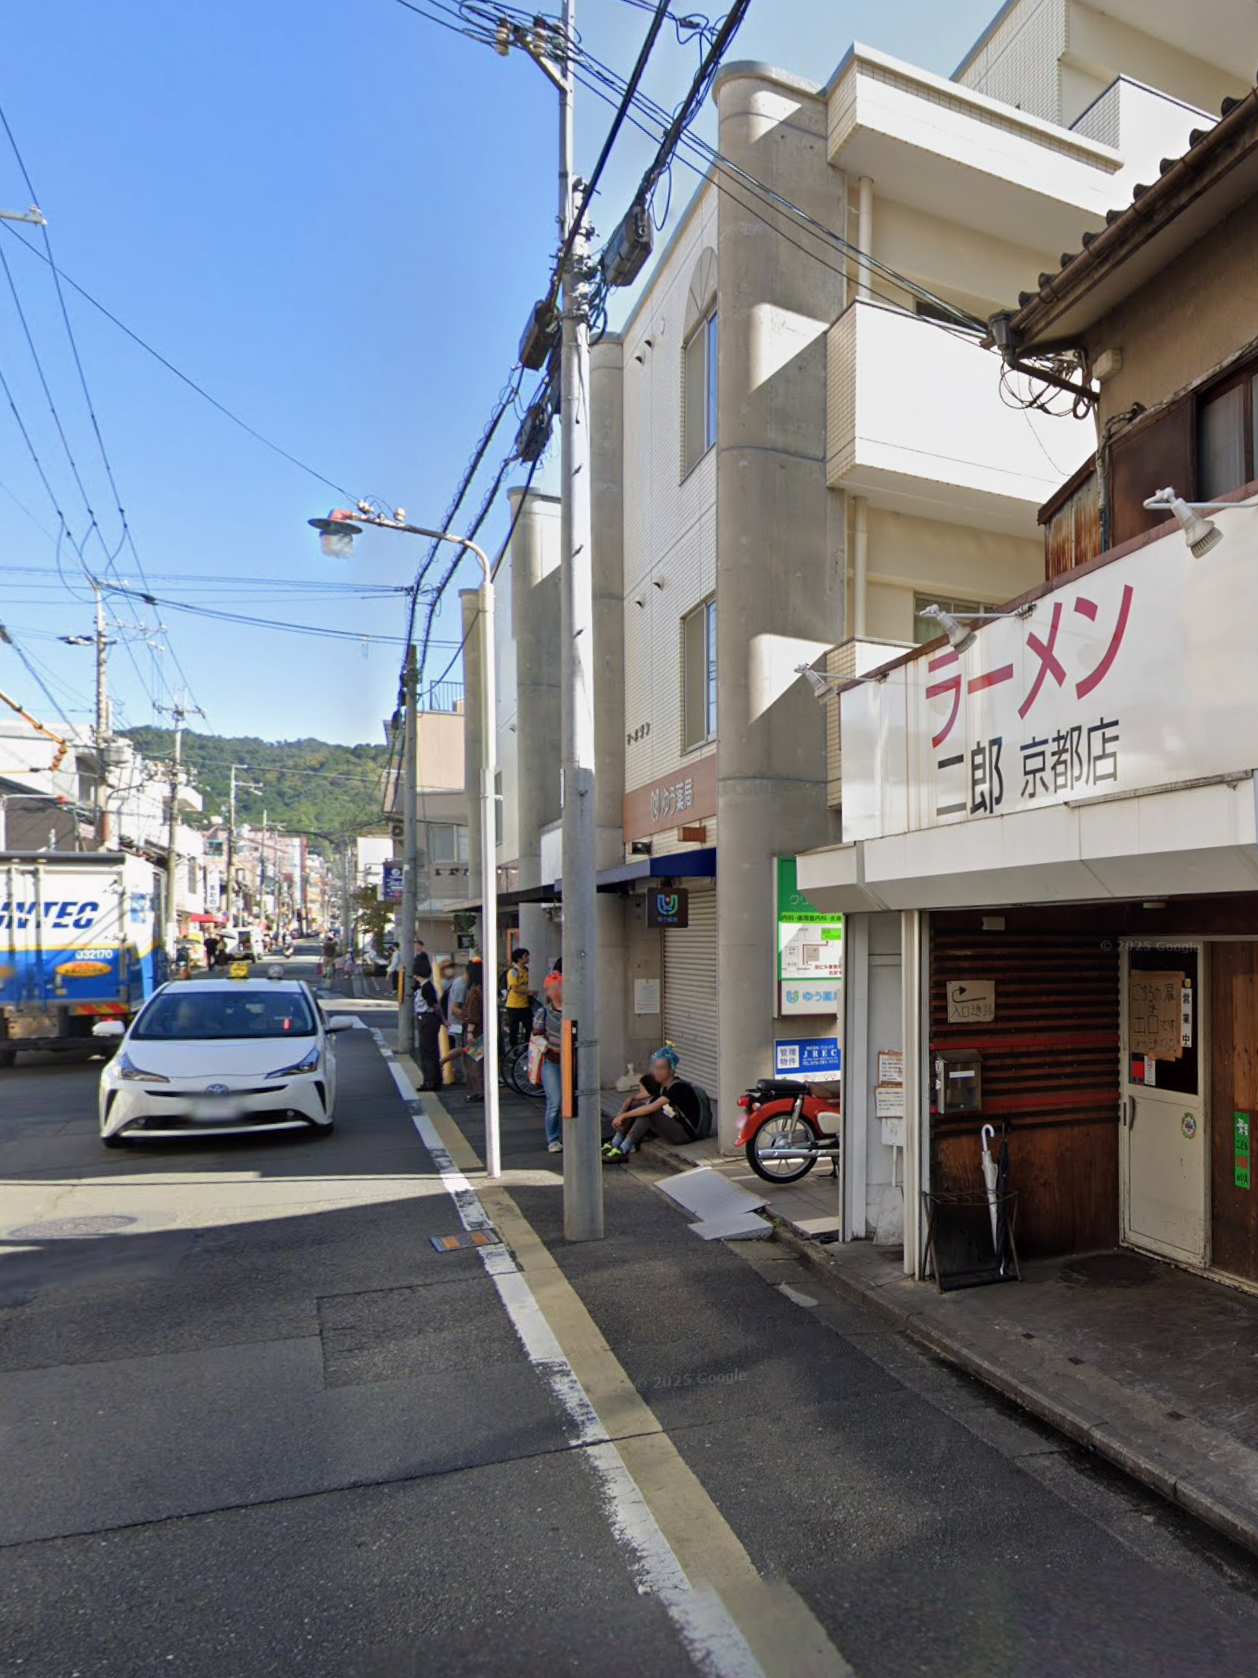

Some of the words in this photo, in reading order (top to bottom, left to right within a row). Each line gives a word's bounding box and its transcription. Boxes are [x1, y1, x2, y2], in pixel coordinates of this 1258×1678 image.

[925, 584, 1134, 749] ラーメン
[936, 736, 1003, 817] 二郎
[1019, 717, 1119, 800] 京都店
[1134, 1013, 1176, 1035] 出口です
[1182, 993, 1191, 1046] 営業中
[780, 1048, 796, 1056] 管理
[780, 1057, 796, 1066] 物件
